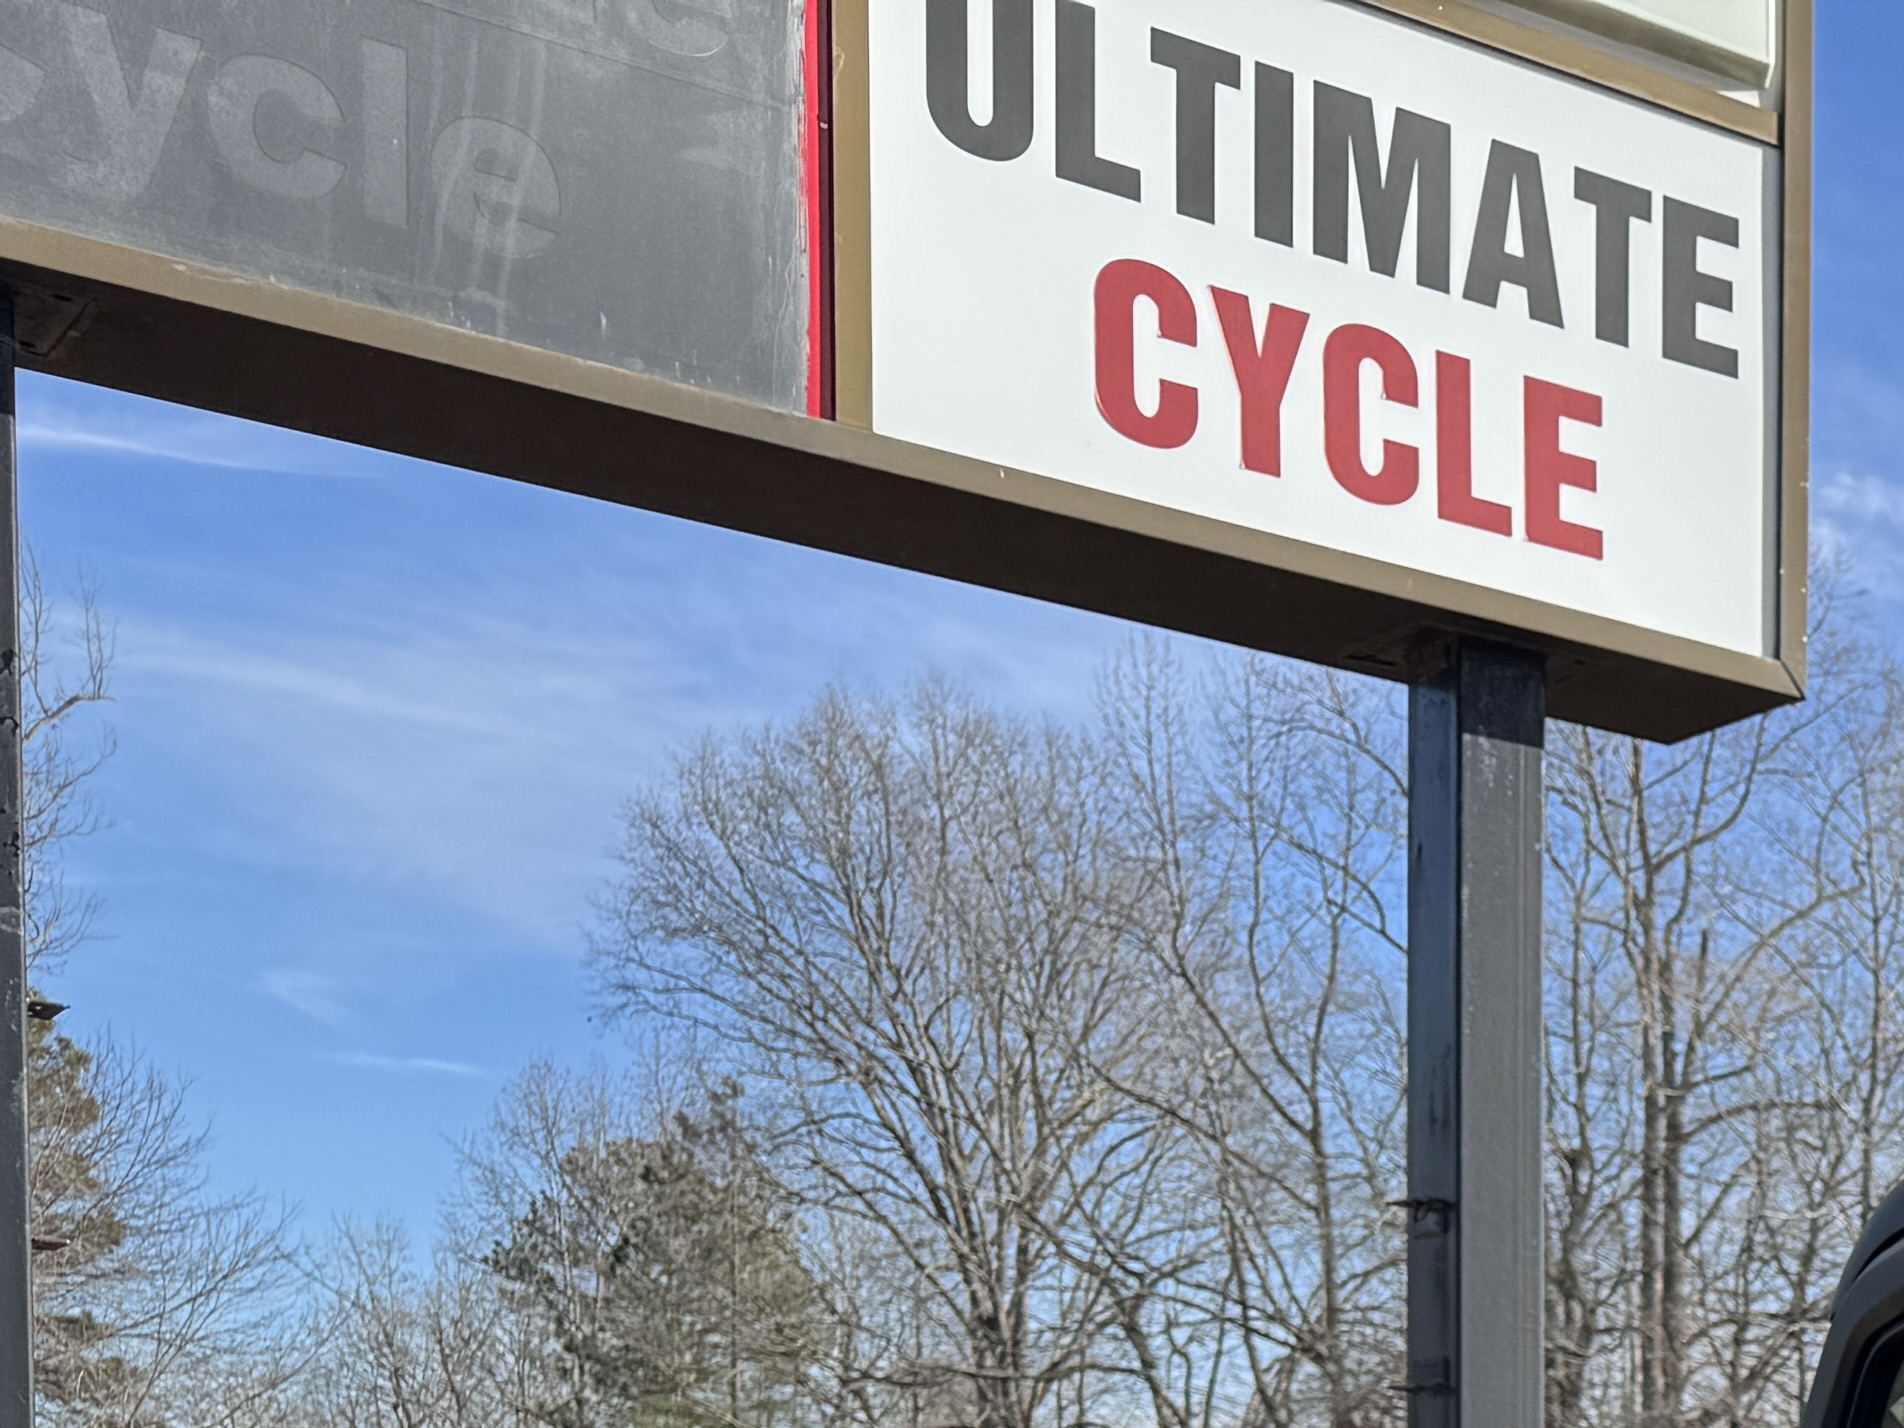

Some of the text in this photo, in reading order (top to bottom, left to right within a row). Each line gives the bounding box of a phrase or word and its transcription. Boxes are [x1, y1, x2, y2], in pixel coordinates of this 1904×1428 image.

[0, 2, 562, 259] ycle
[926, 0, 1740, 379] ULTIMATE
[1093, 257, 1604, 561] CYCLE
